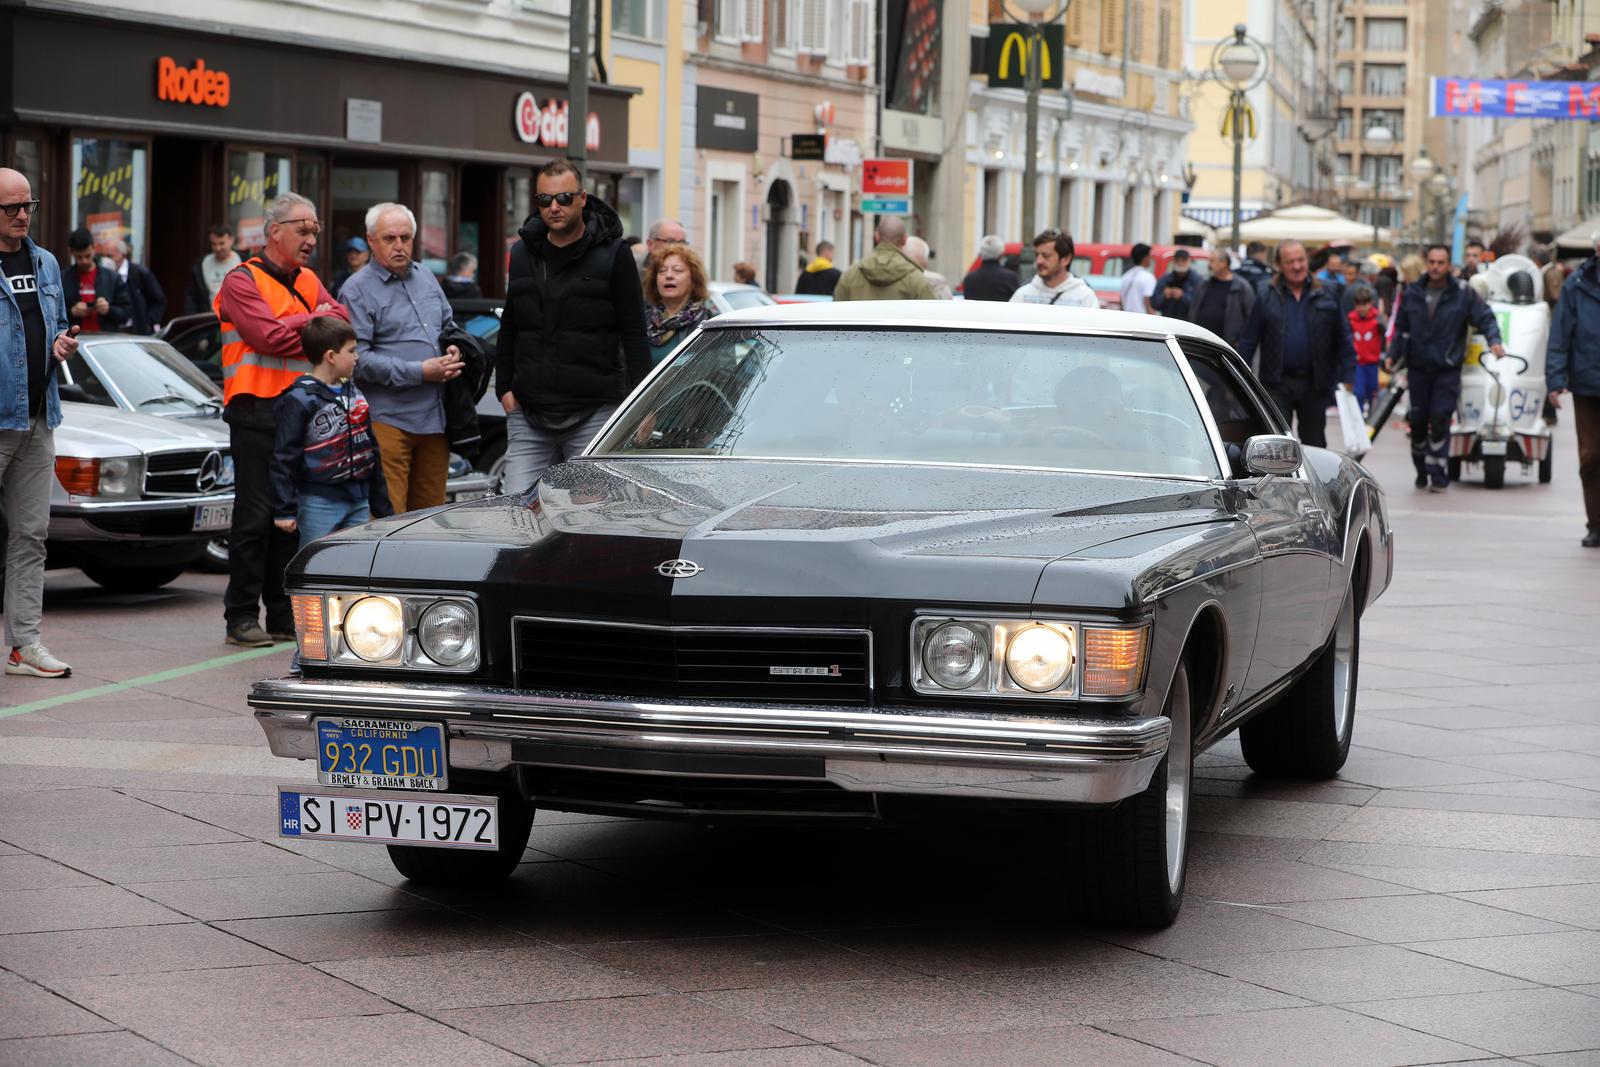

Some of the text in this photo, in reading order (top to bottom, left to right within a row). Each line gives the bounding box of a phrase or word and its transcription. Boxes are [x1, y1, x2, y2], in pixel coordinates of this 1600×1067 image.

[159, 56, 230, 107] Rodea
[345, 719, 412, 731] SACRAMENTO
[351, 729, 408, 740] CALIFORNIA
[325, 741, 438, 779] 932 GDU
[372, 776, 405, 789] GRAHAM
[284, 818, 300, 830] HR
